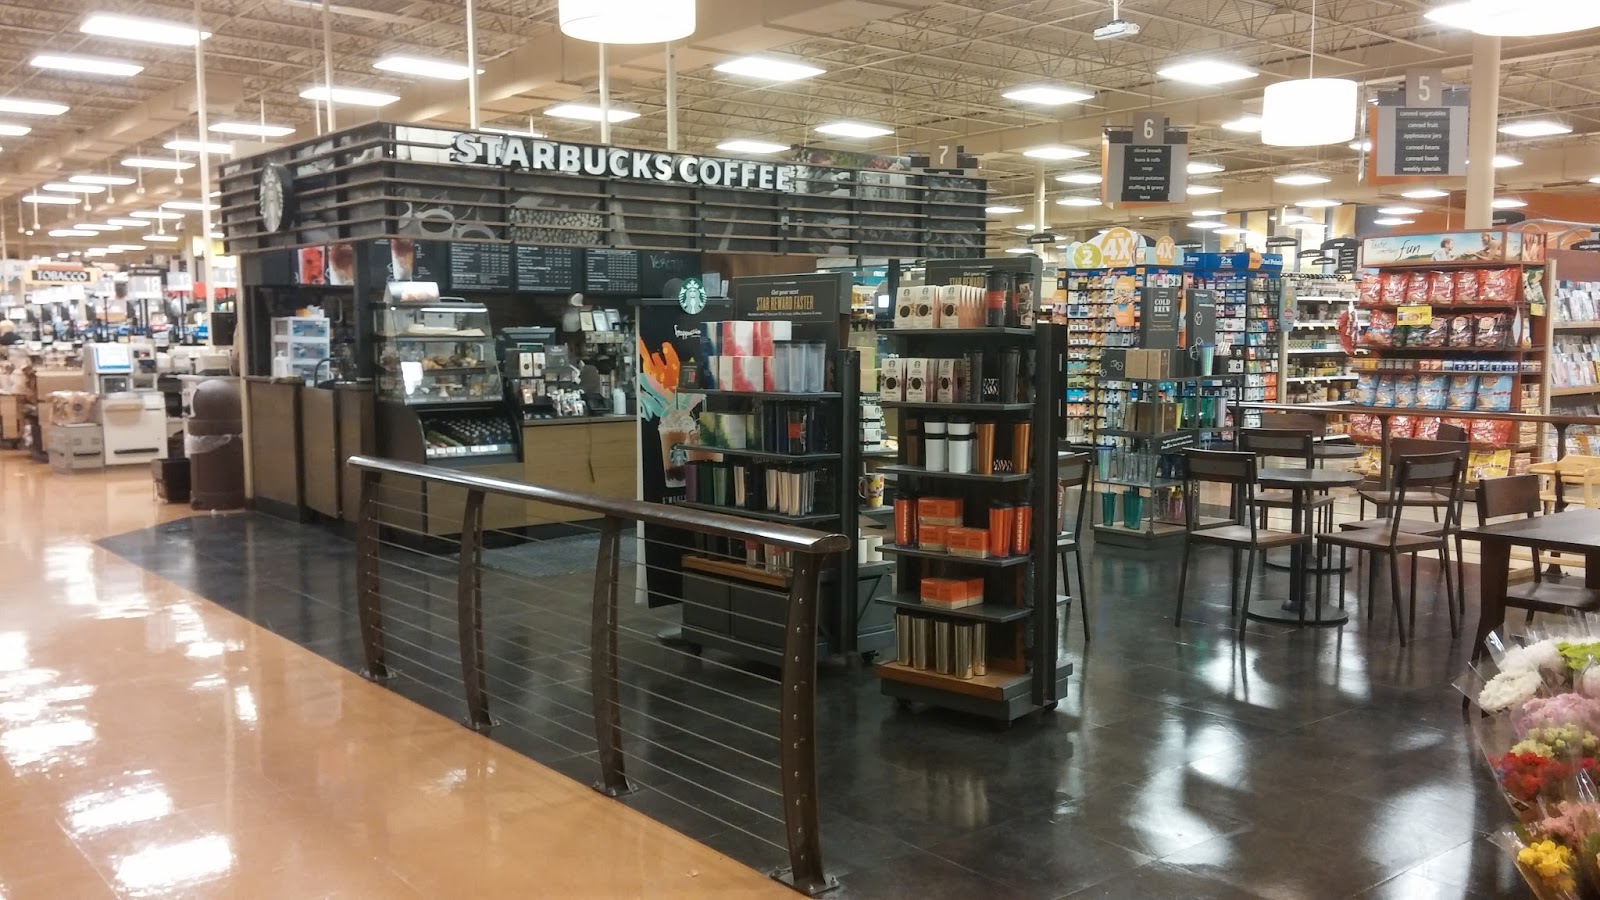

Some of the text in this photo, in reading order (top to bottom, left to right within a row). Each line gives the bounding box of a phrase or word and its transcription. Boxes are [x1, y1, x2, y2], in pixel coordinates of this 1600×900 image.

[1418, 76, 1430, 101] 5
[1143, 118, 1154, 139] 6
[455, 133, 791, 191] STARBUCKS COFFEE
[938, 145, 949, 165] 7
[1082, 249, 1093, 264] 2
[1103, 238, 1131, 260] 4X
[1156, 242, 1173, 259] 4X
[1394, 240, 1421, 261] fun
[36, 270, 87, 281] TOBACCO
[756, 295, 814, 311] STAR REWARD FASTER
